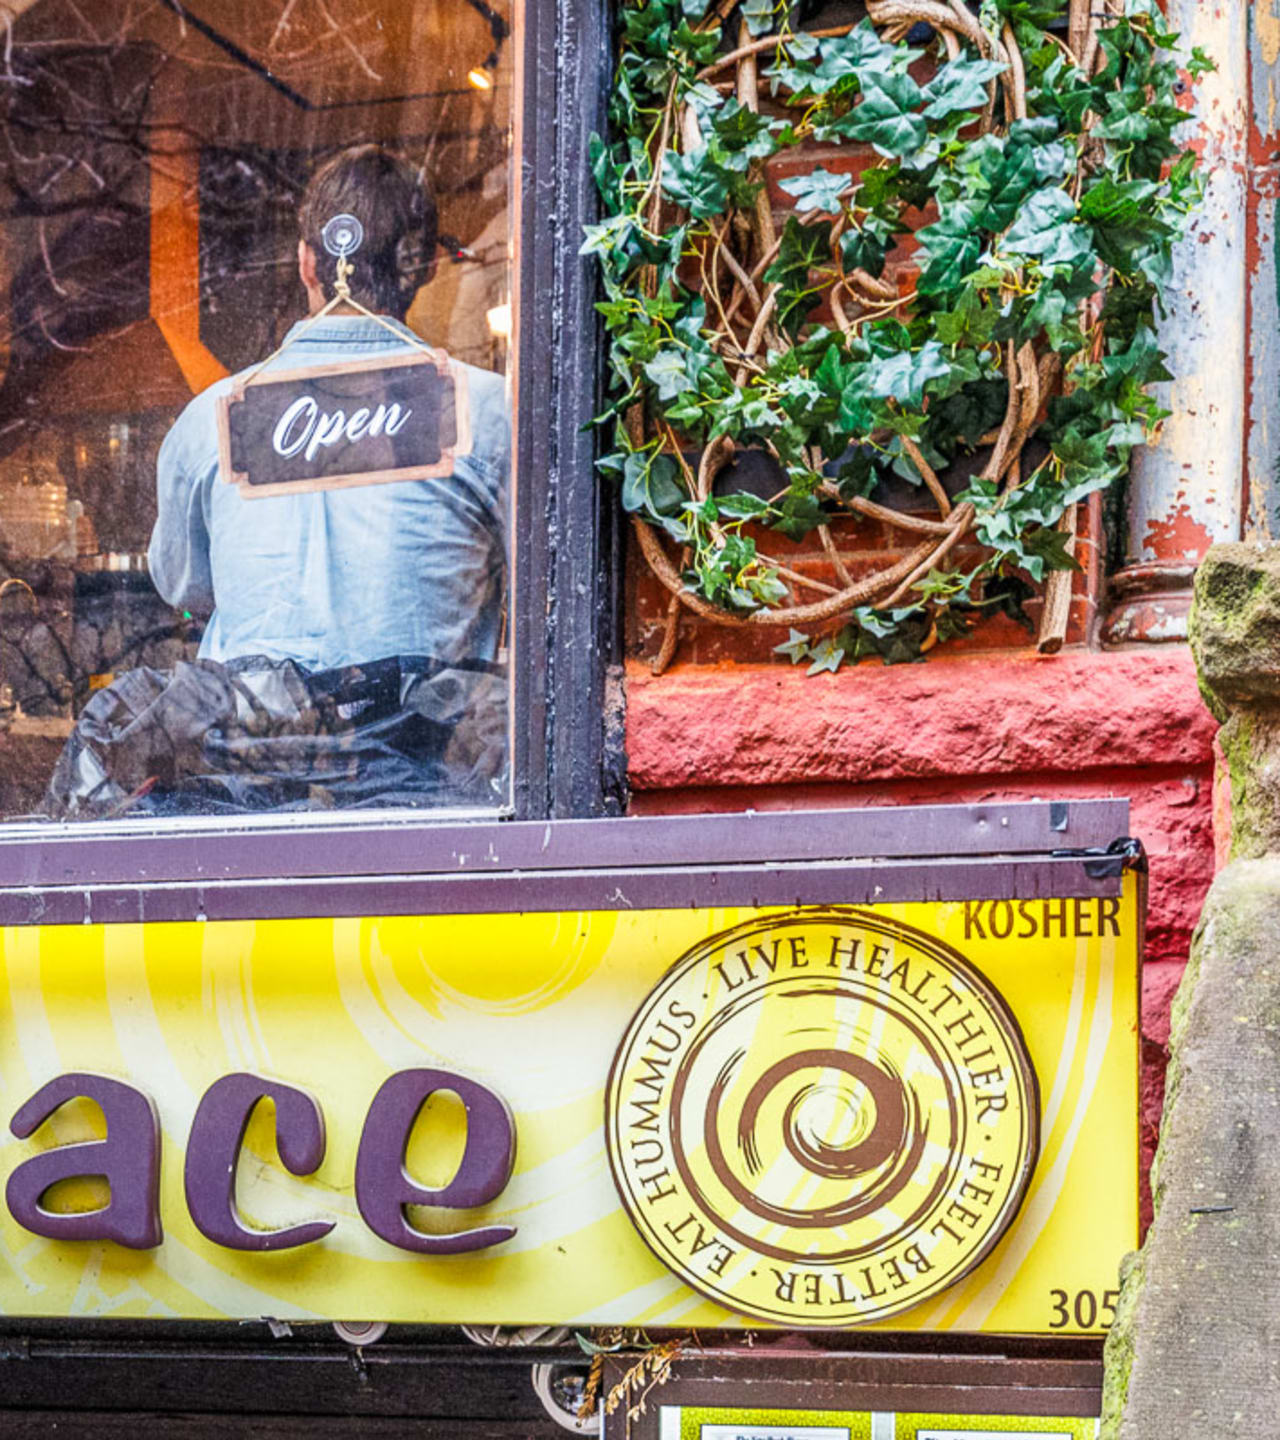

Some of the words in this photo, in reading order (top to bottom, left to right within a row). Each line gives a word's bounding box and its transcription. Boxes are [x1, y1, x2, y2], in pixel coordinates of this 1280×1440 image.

[272, 395, 412, 462] Open
[964, 897, 1121, 939] KOSHER
[713, 936, 809, 993] LIVE
[828, 936, 1008, 1124] HEALTHIER
[630, 1000, 697, 1204] HUMMUS
[943, 1156, 1004, 1246] FEEL
[664, 1212, 738, 1277] EAT
[770, 1244, 935, 1305] BETTER
